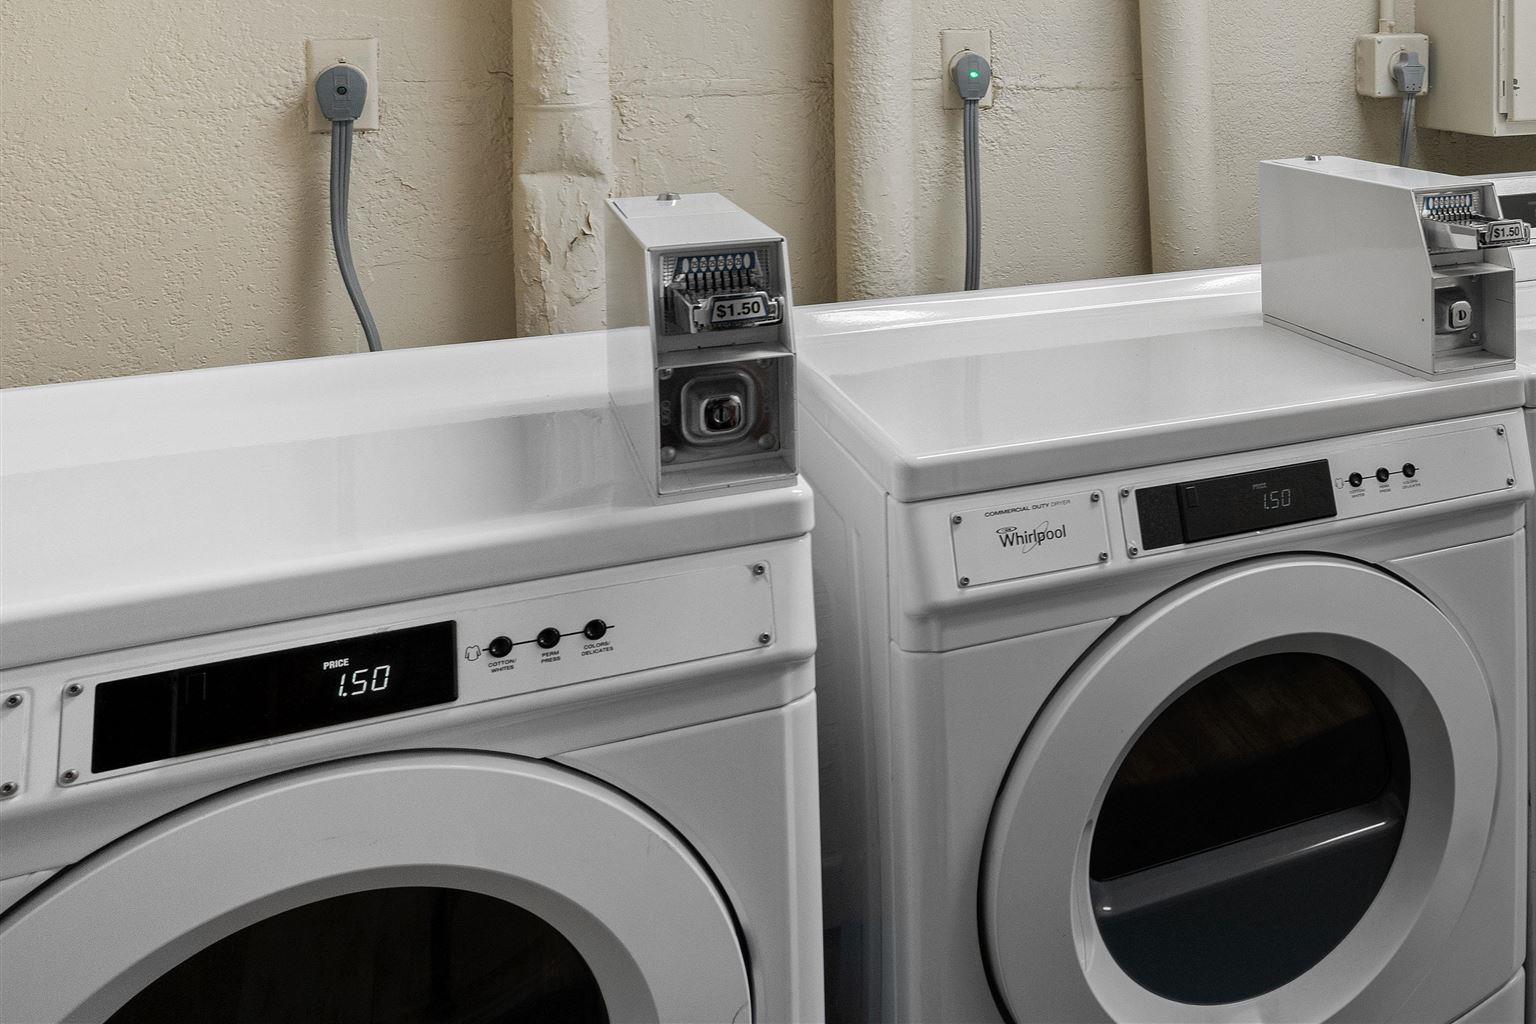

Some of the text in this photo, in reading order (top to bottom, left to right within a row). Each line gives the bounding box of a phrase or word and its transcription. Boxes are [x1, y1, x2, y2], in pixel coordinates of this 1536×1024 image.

[1493, 226, 1520, 238] $1.50
[716, 300, 761, 318] $1.50
[1263, 488, 1291, 510] 1.50
[984, 506, 1031, 517] COMMERCIAL
[1031, 502, 1050, 510] DUTY
[998, 524, 1067, 547] Whirlpool
[541, 650, 560, 658] PERM
[581, 646, 614, 657] DELICATES
[323, 658, 350, 670] PRICE
[541, 656, 562, 664] PRESS
[491, 664, 515, 673] WHITES
[338, 664, 391, 697] 1.50
